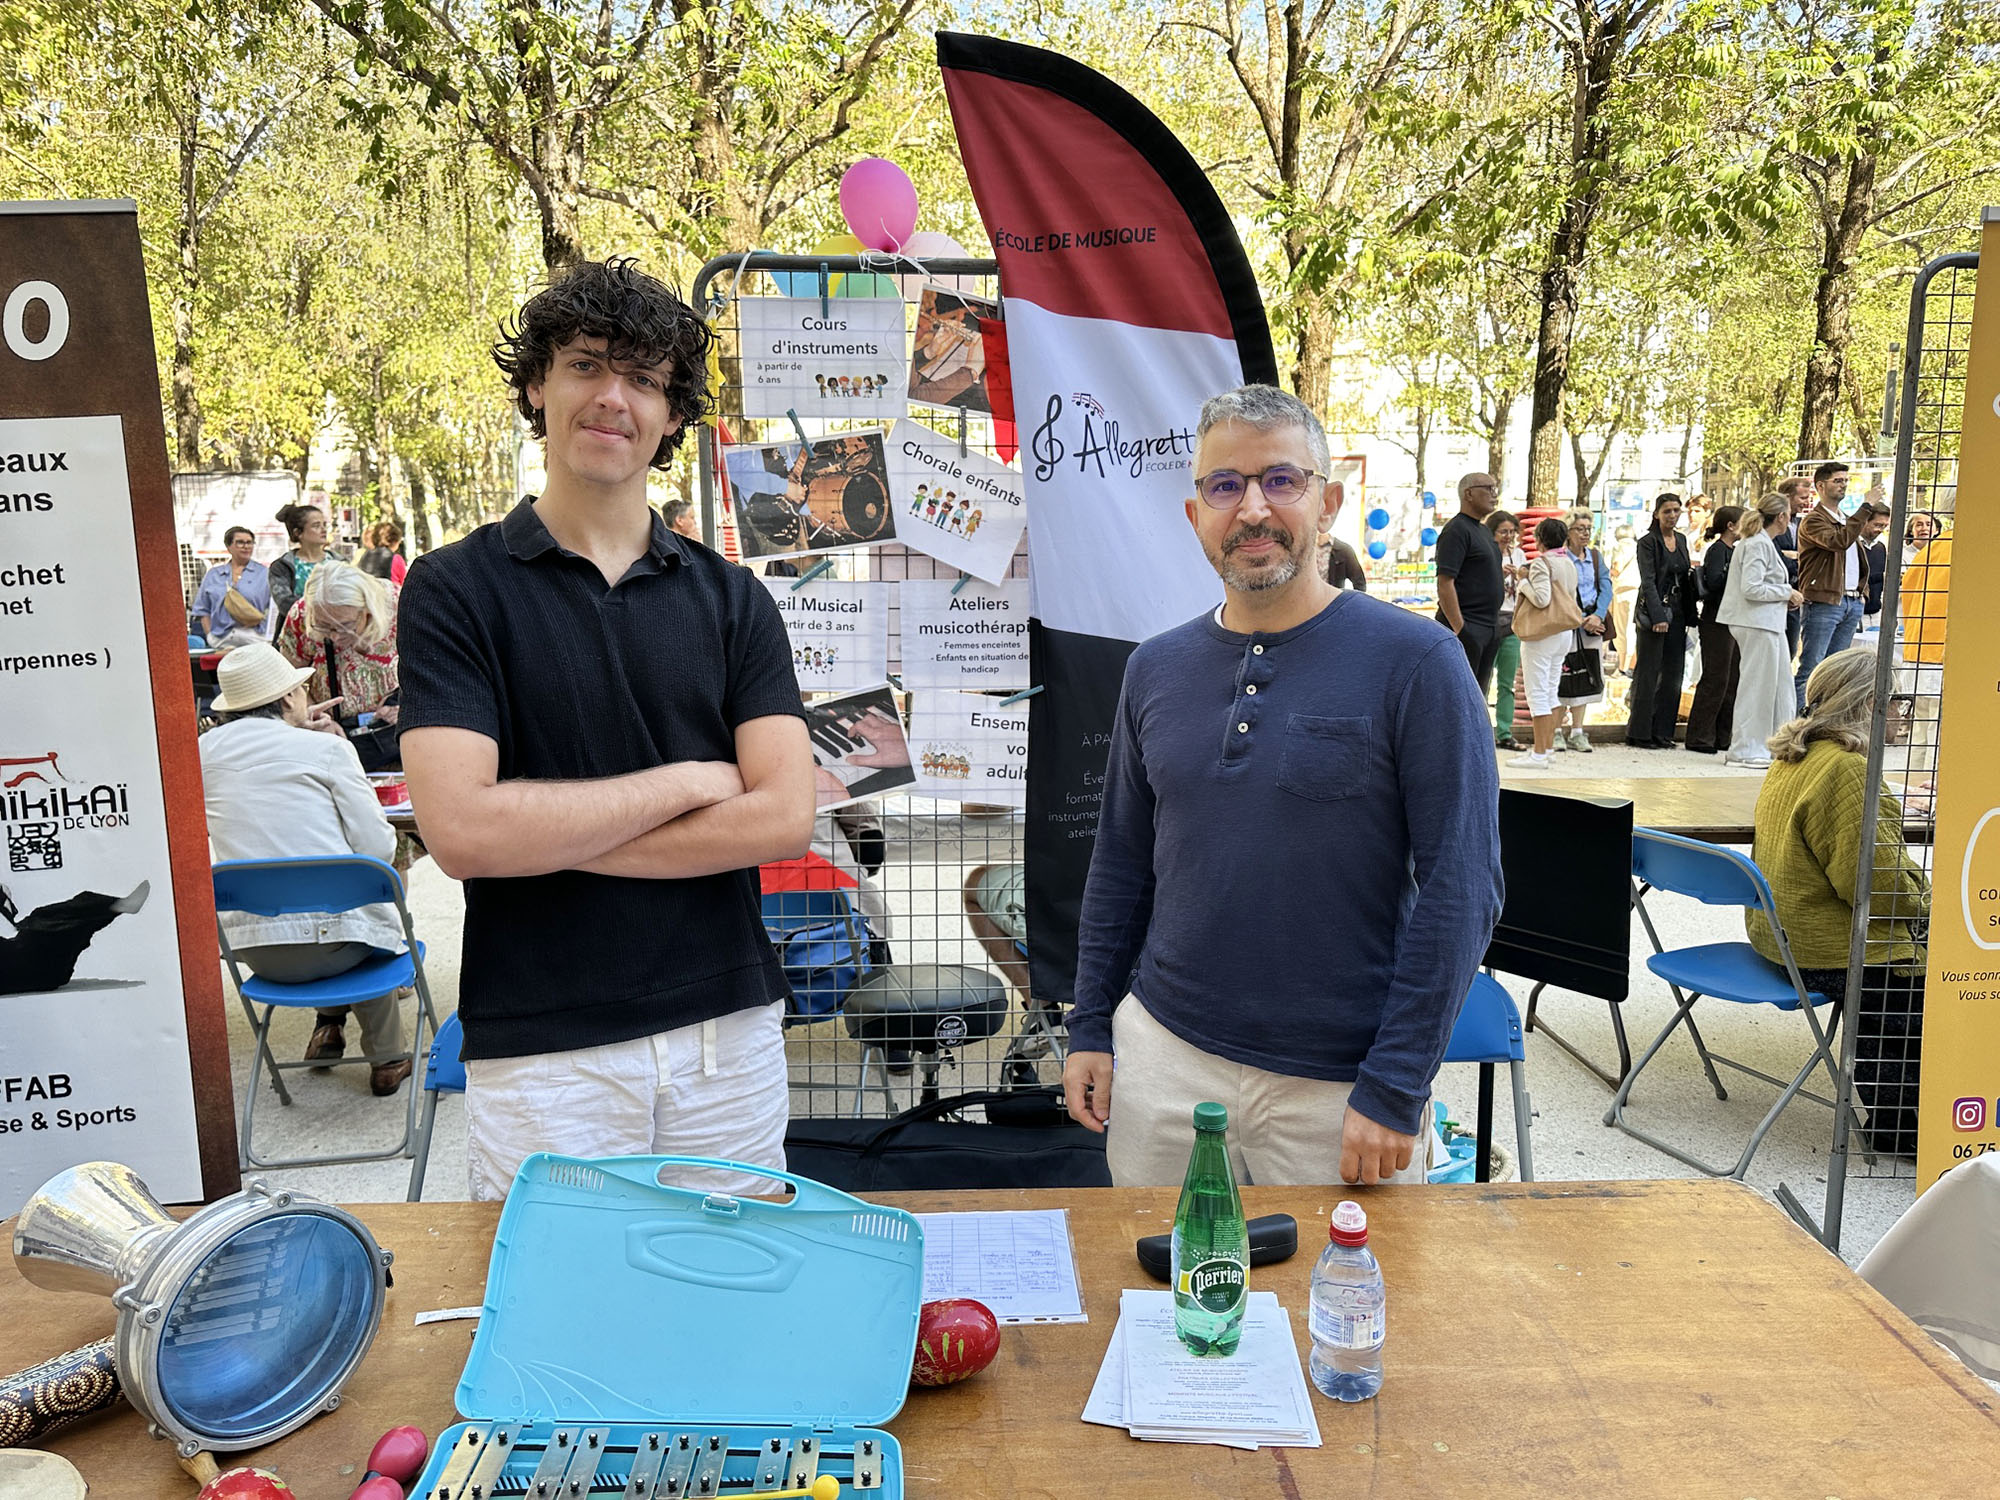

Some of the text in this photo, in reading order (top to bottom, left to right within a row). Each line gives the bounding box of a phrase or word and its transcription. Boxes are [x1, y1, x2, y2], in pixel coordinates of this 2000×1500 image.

[995, 227, 1157, 253] ÉCOLE DE MUSIQUE
[801, 316, 848, 331] Cours
[772, 339, 879, 355] d'instruments
[757, 361, 803, 372] à partir de
[757, 375, 781, 384] 6 ans
[0, 452, 69, 473] aux
[1145, 460, 1173, 472] ÉCOLE
[1175, 460, 1187, 470] DE
[902, 441, 1022, 506] Chorale enfants
[0, 563, 66, 587] chet
[801, 597, 863, 613] Musical
[949, 596, 1010, 611] Ateliers
[807, 620, 822, 630] de
[825, 620, 833, 631] 3
[835, 623, 855, 632] ans
[944, 641, 980, 650] Femmes
[981, 640, 1021, 649] enceintes
[0, 651, 98, 674] rpennes
[935, 653, 967, 662] Enfants
[980, 652, 1017, 661] situation
[1017, 651, 1030, 661] de
[961, 665, 1000, 675] handicap
[971, 712, 1026, 731] Ensem
[1006, 744, 1027, 756] vo
[91, 813, 129, 828] LYON
[1941, 970, 1971, 982] Vous
[1959, 989, 1987, 1001] Vous
[0, 1074, 72, 1102] FAB
[31, 1112, 48, 1130] &
[56, 1105, 136, 1131] Sports
[1953, 1144, 1973, 1158] 06
